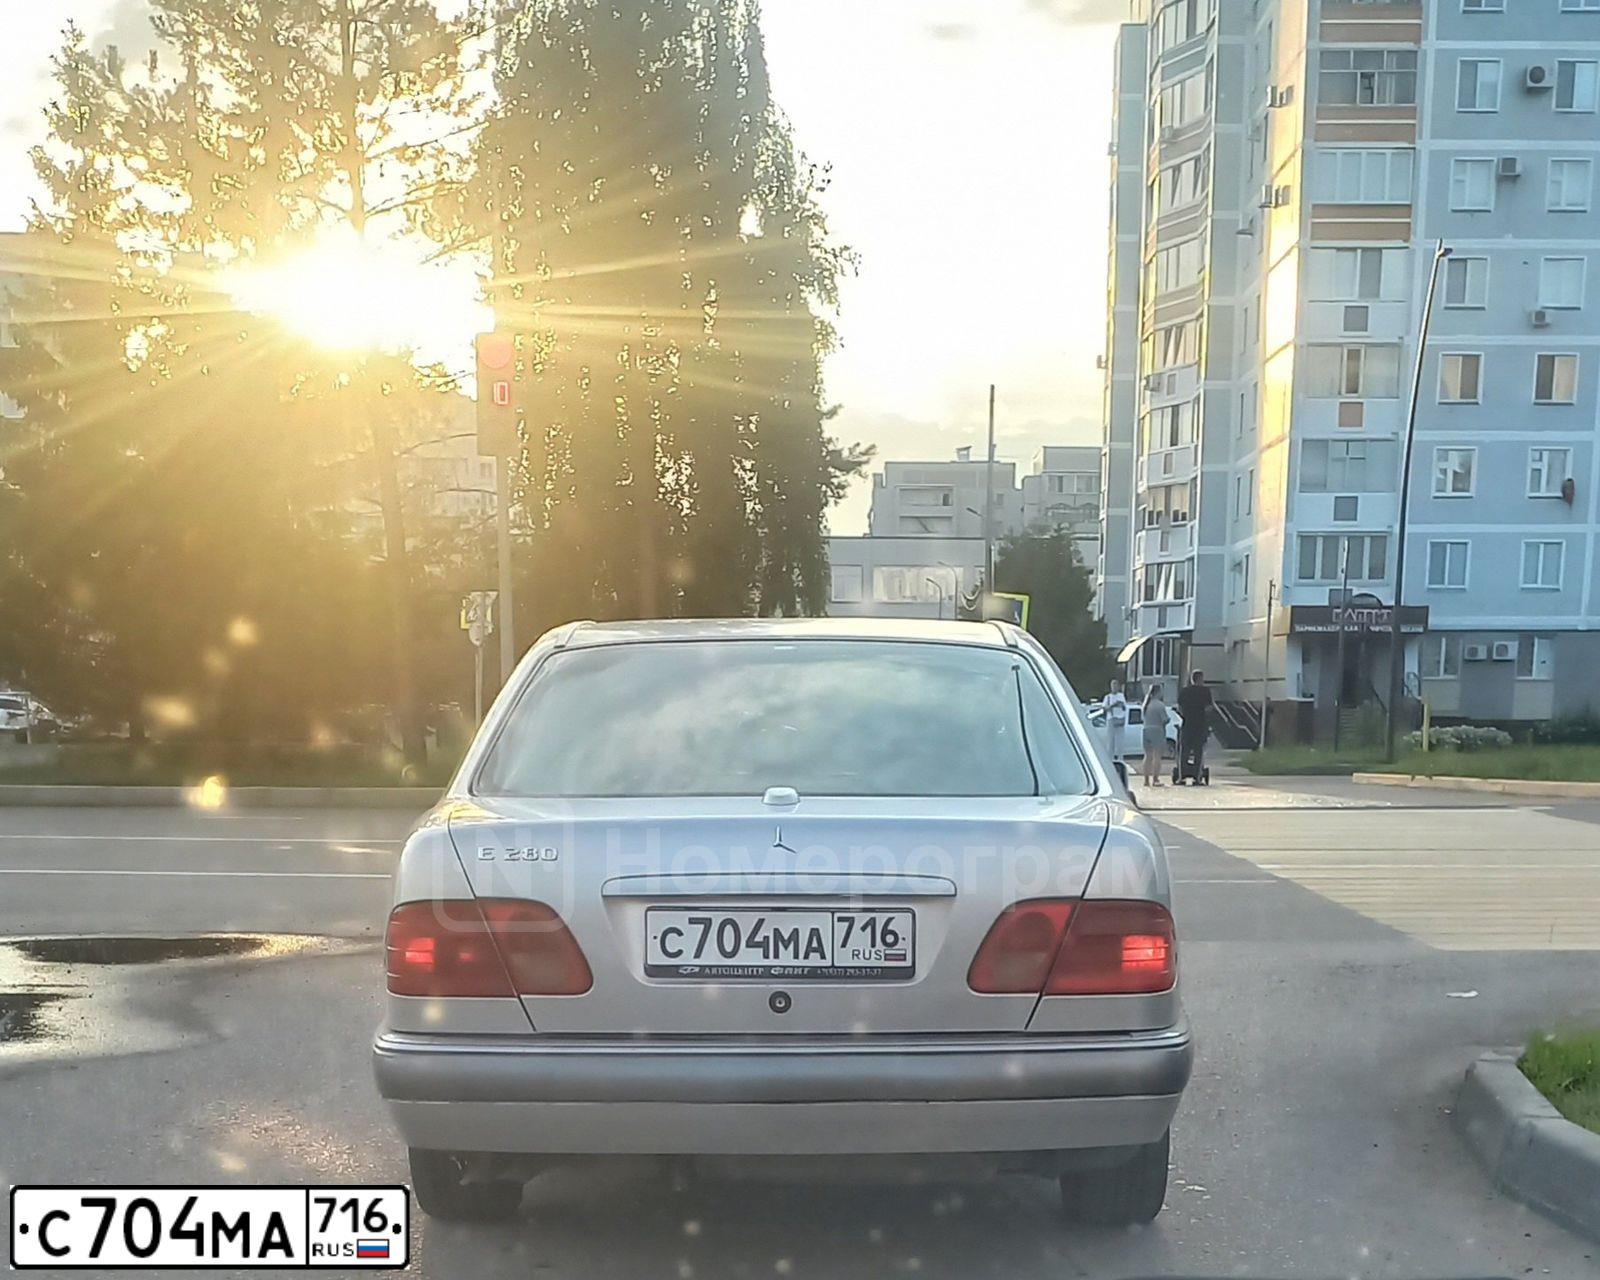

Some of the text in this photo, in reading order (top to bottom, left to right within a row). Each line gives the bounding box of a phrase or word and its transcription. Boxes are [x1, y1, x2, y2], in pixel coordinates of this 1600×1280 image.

[477, 847, 559, 862] E 280
[836, 916, 900, 949] 716
[851, 949, 883, 961] RUS
